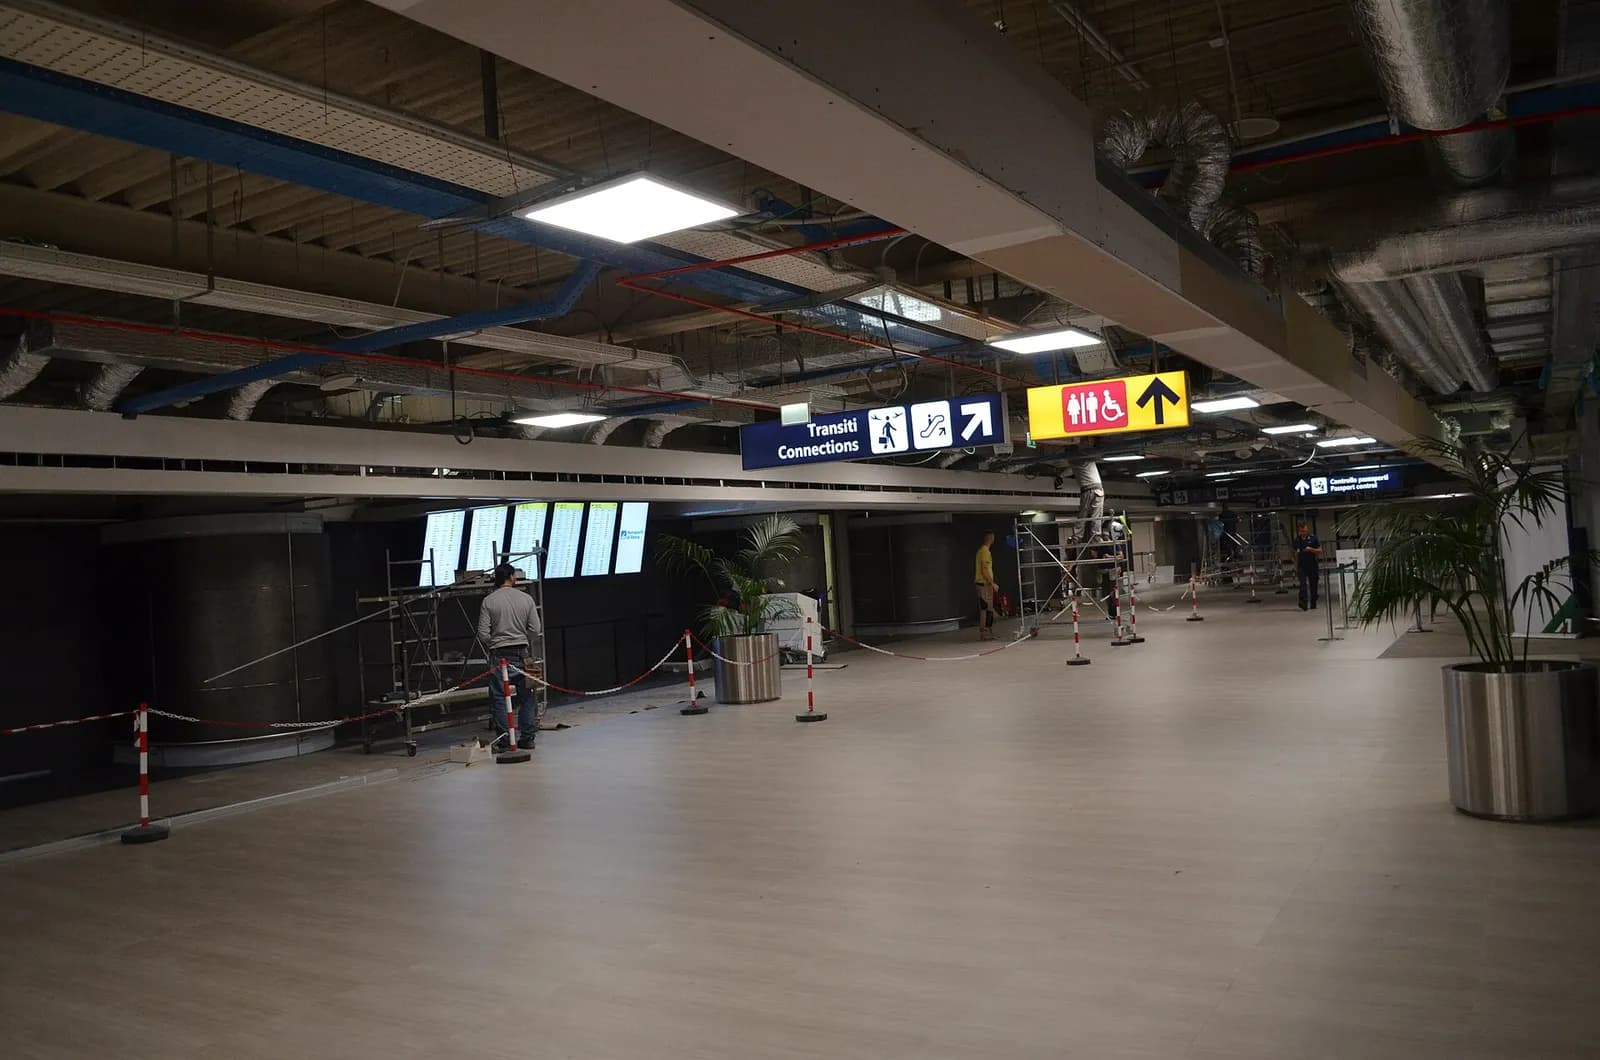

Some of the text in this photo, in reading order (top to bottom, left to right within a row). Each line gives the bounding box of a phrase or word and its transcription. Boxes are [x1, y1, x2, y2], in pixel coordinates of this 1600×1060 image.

[808, 418, 857, 437] Transiti
[778, 440, 859, 459] Connections
[1330, 484, 1355, 492] Passport
